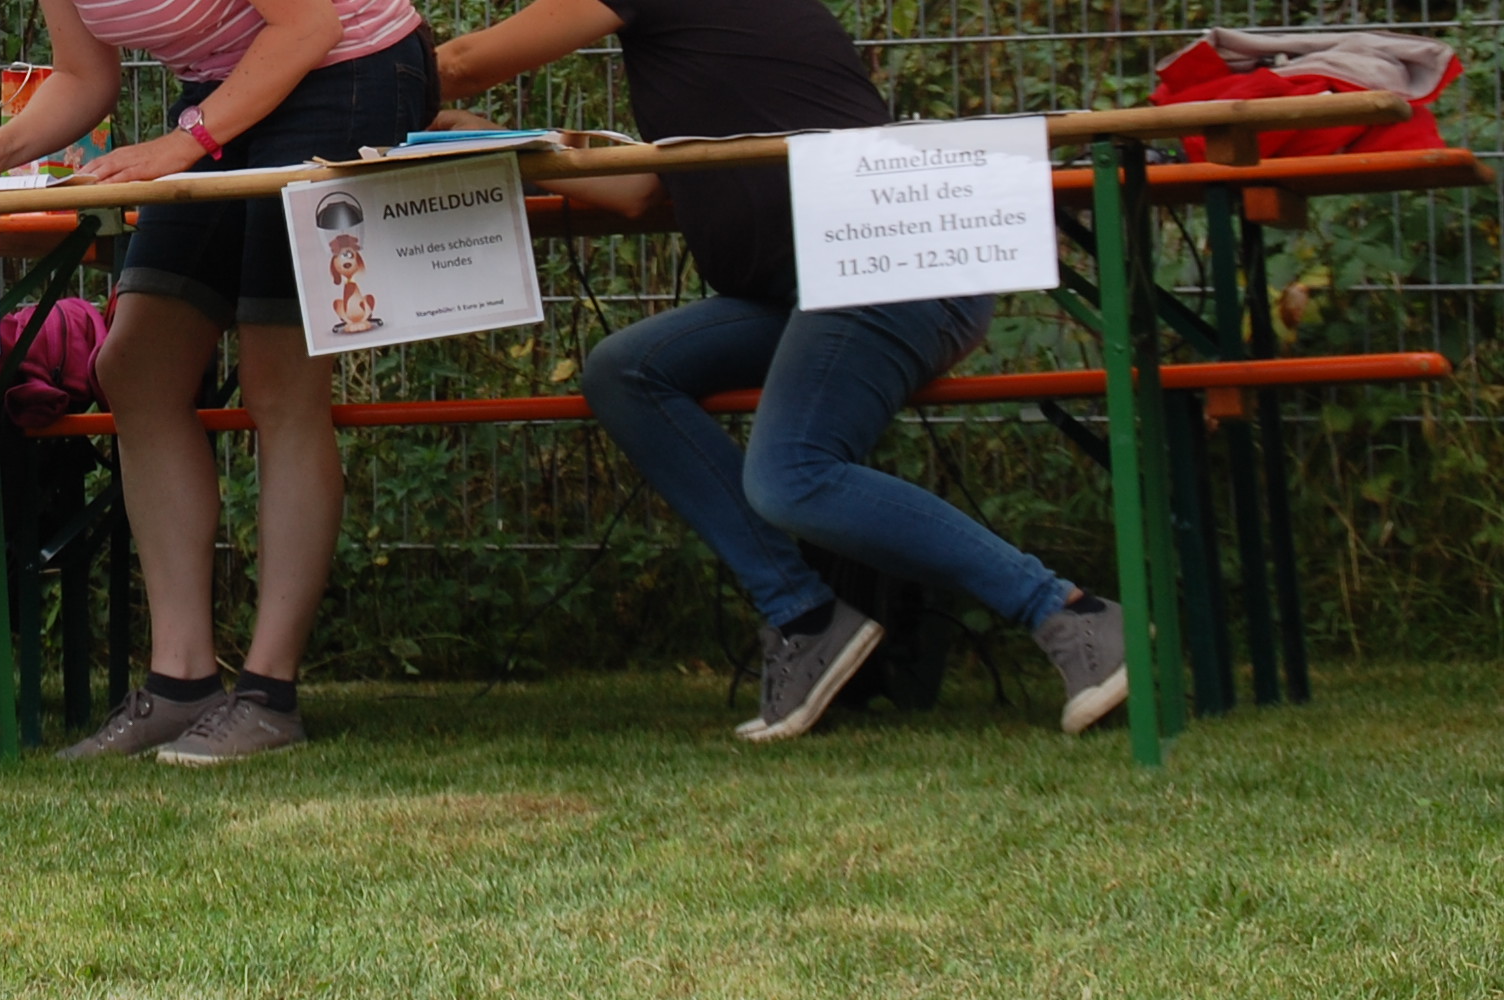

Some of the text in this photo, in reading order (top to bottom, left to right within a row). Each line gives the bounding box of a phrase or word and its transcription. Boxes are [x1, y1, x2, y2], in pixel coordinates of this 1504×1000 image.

[855, 148, 988, 173] Anmeldung
[383, 187, 503, 220] ANMELDUNG
[871, 182, 973, 206] Wahl des
[825, 208, 1026, 243] schönsten Hundes
[396, 233, 503, 258] Wahl des schönsten
[432, 256, 472, 270] Hundes
[837, 255, 890, 277] 11.30
[915, 247, 968, 269] 12.30
[976, 245, 1018, 263] Uhr
